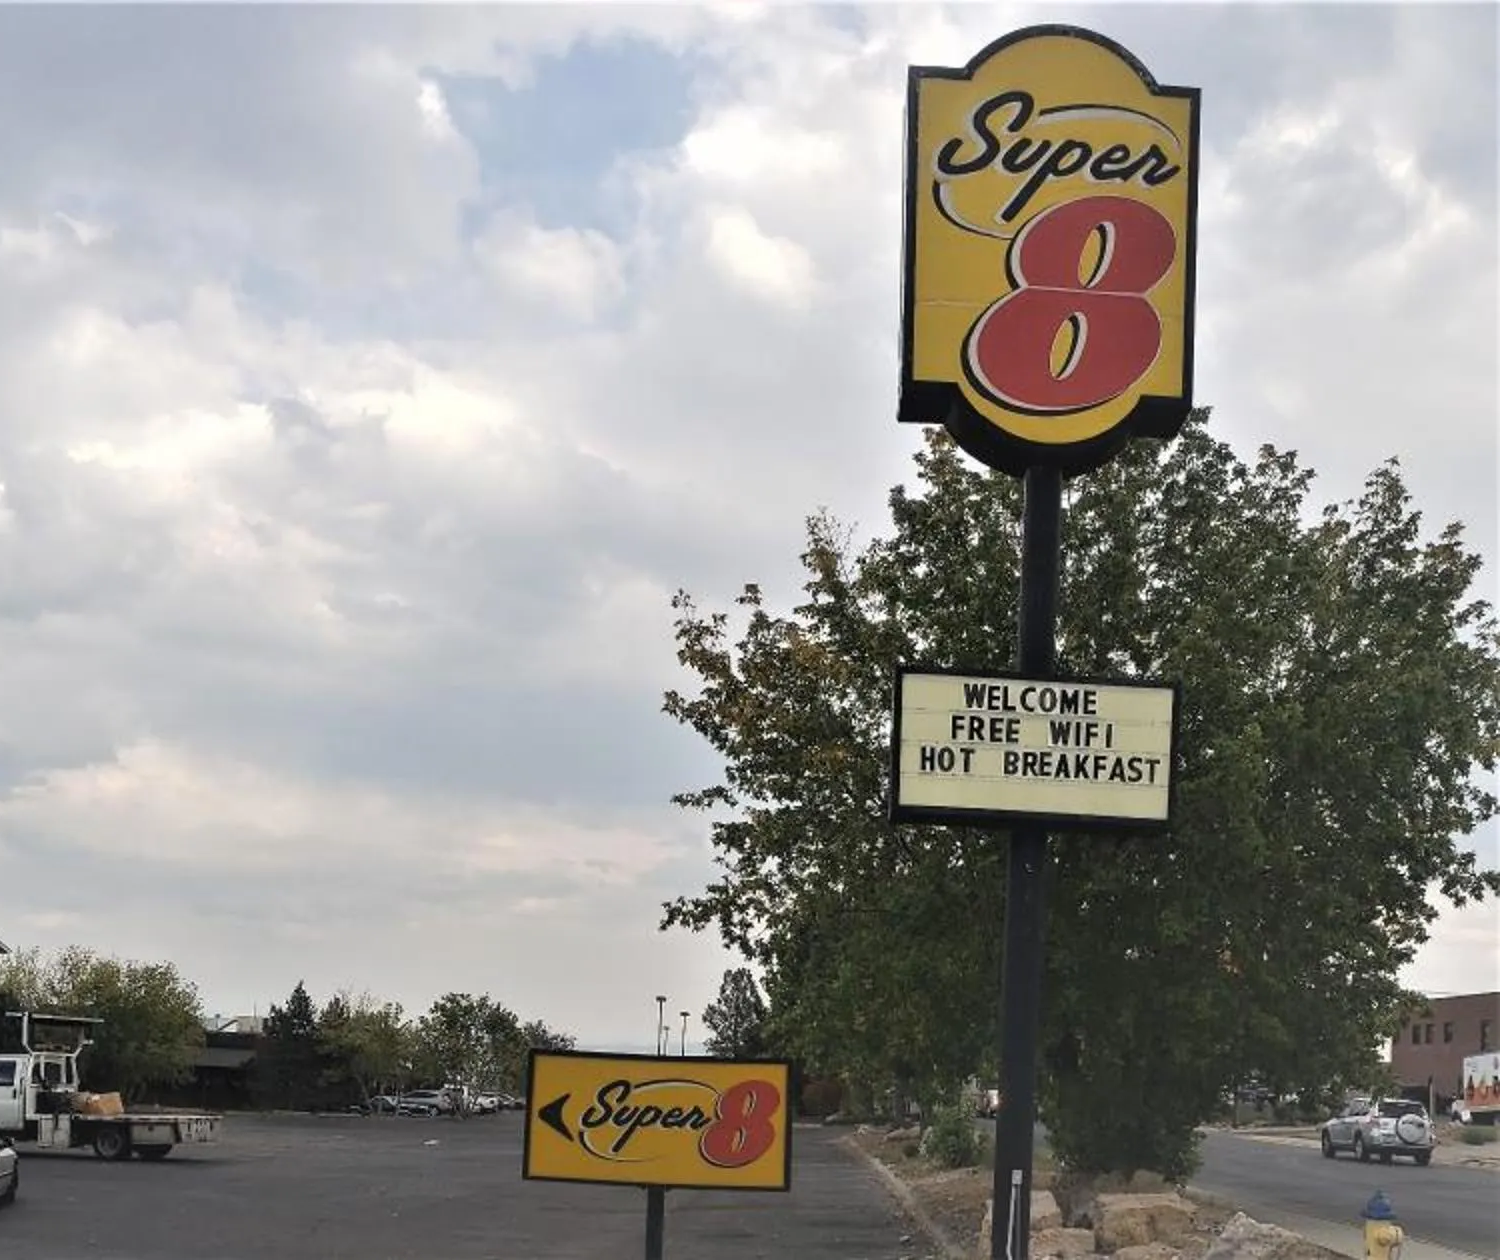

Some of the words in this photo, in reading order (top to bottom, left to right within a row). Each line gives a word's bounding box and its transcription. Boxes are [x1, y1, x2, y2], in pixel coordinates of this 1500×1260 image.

[937, 90, 1182, 224] Super
[960, 194, 1178, 417] 8
[963, 683, 1097, 715] WELCOME
[951, 715, 1021, 743] FREE
[1050, 720, 1113, 748] WIFI
[920, 746, 976, 773] HOT
[1003, 751, 1161, 784] BREAKFAST
[581, 1079, 712, 1153] Super
[699, 1079, 781, 1168] 8
